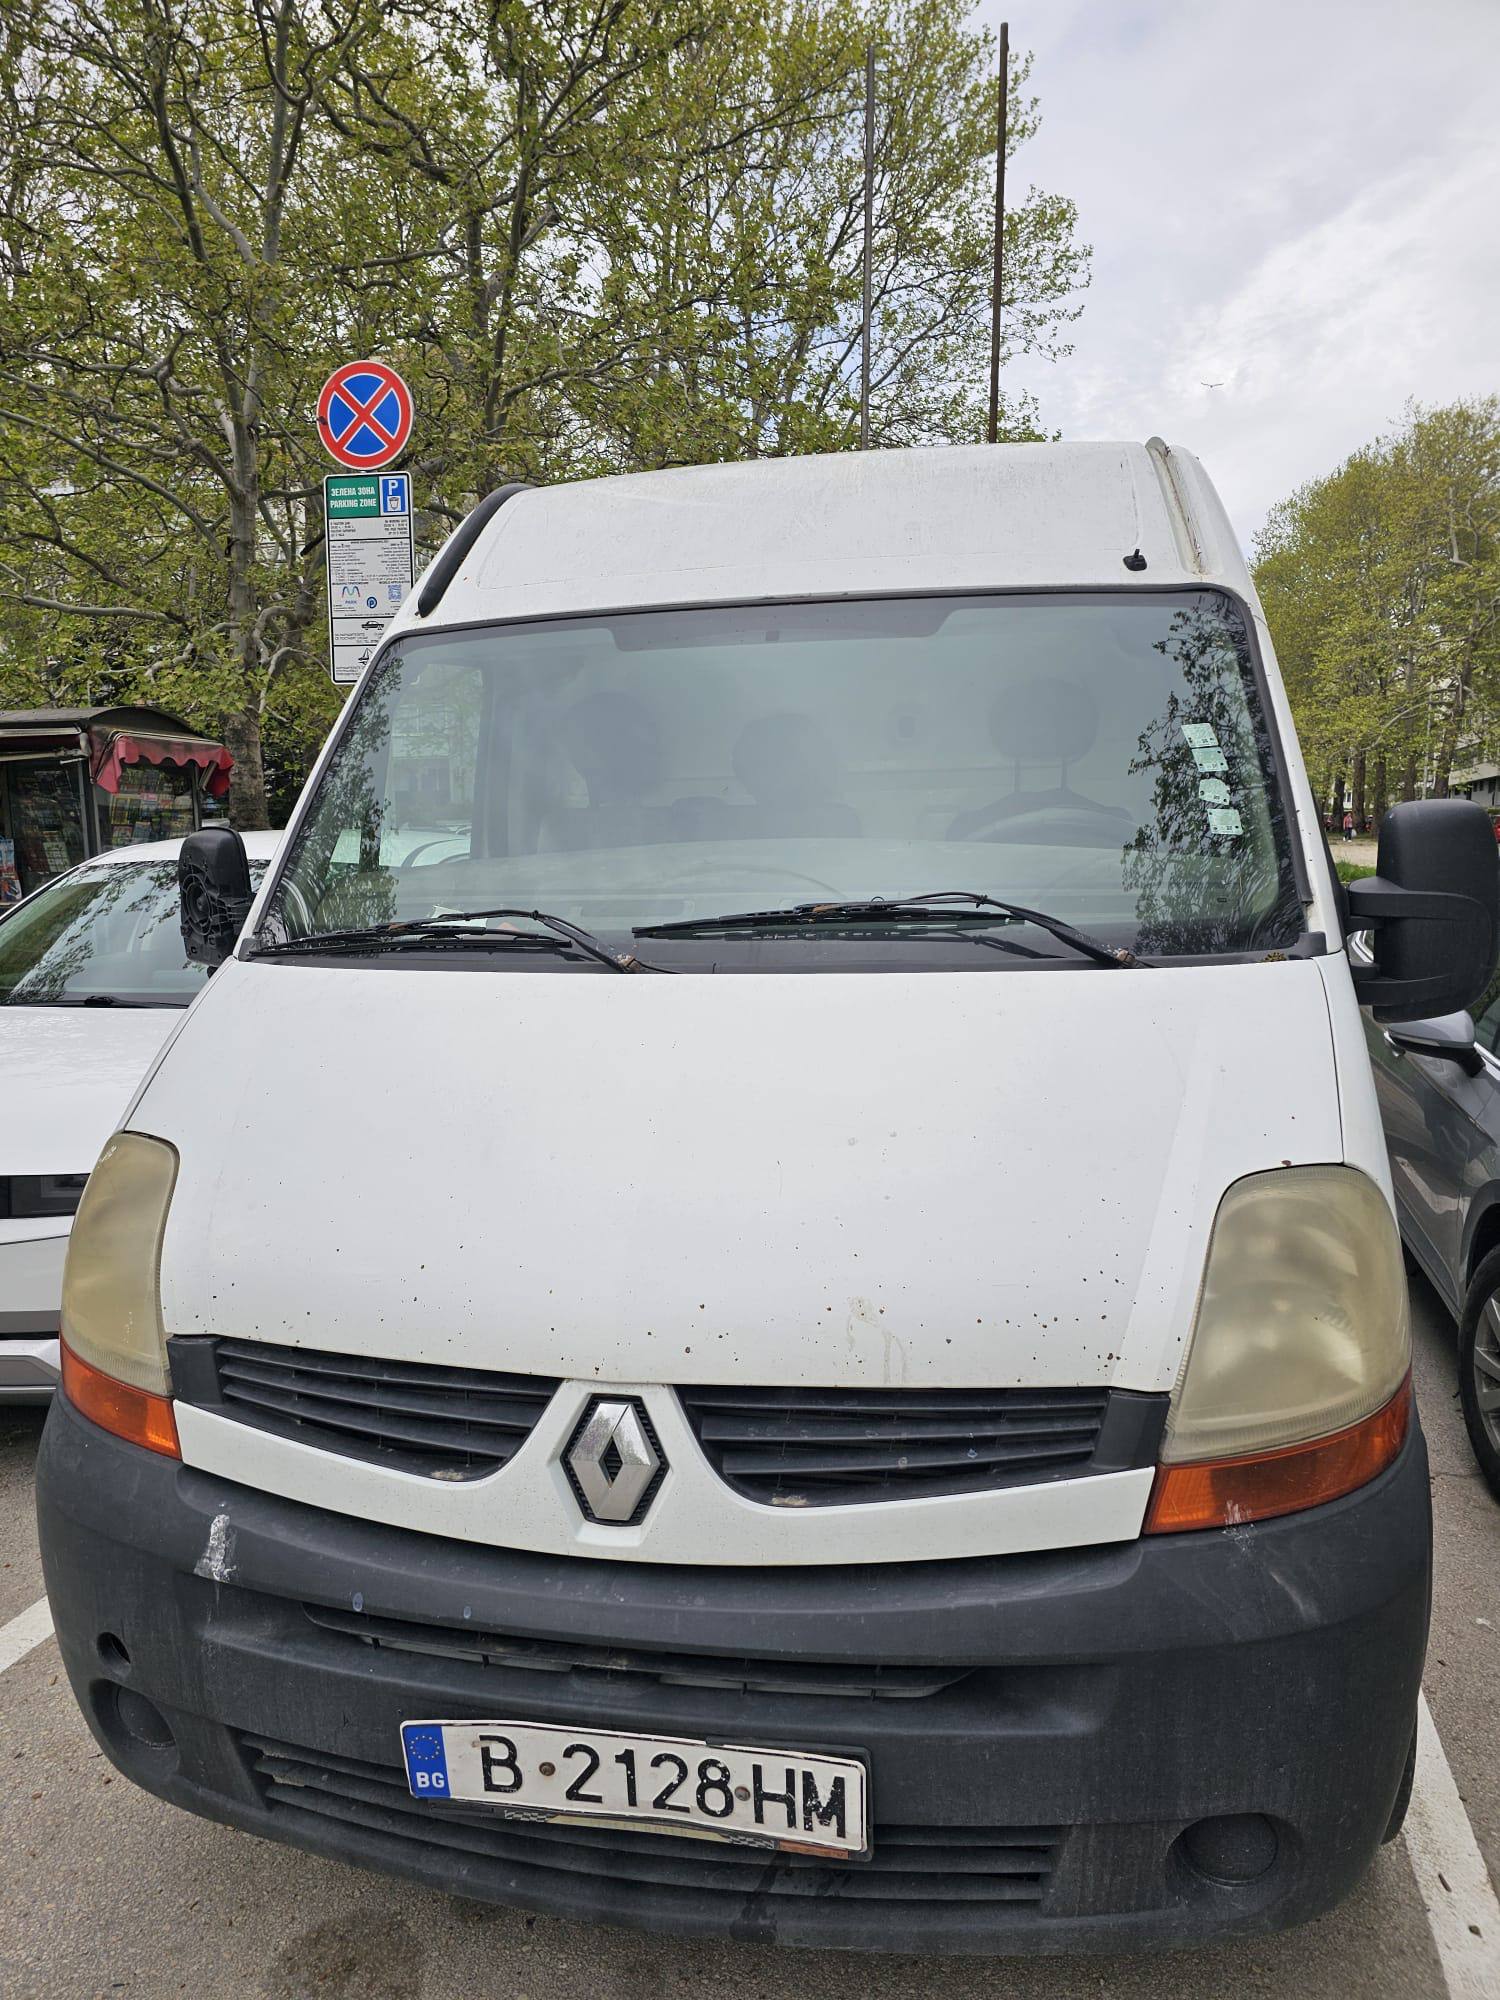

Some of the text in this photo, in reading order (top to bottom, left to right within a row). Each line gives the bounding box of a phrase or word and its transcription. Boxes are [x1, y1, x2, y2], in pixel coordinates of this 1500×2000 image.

[331, 486, 375, 497] ЗЕЛЕНА ЗОНА
[388, 479, 399, 496] P
[330, 498, 377, 509] PARKING ZONE
[416, 1771, 445, 1788] BG
[479, 1734, 847, 1839] B 2128 HM
